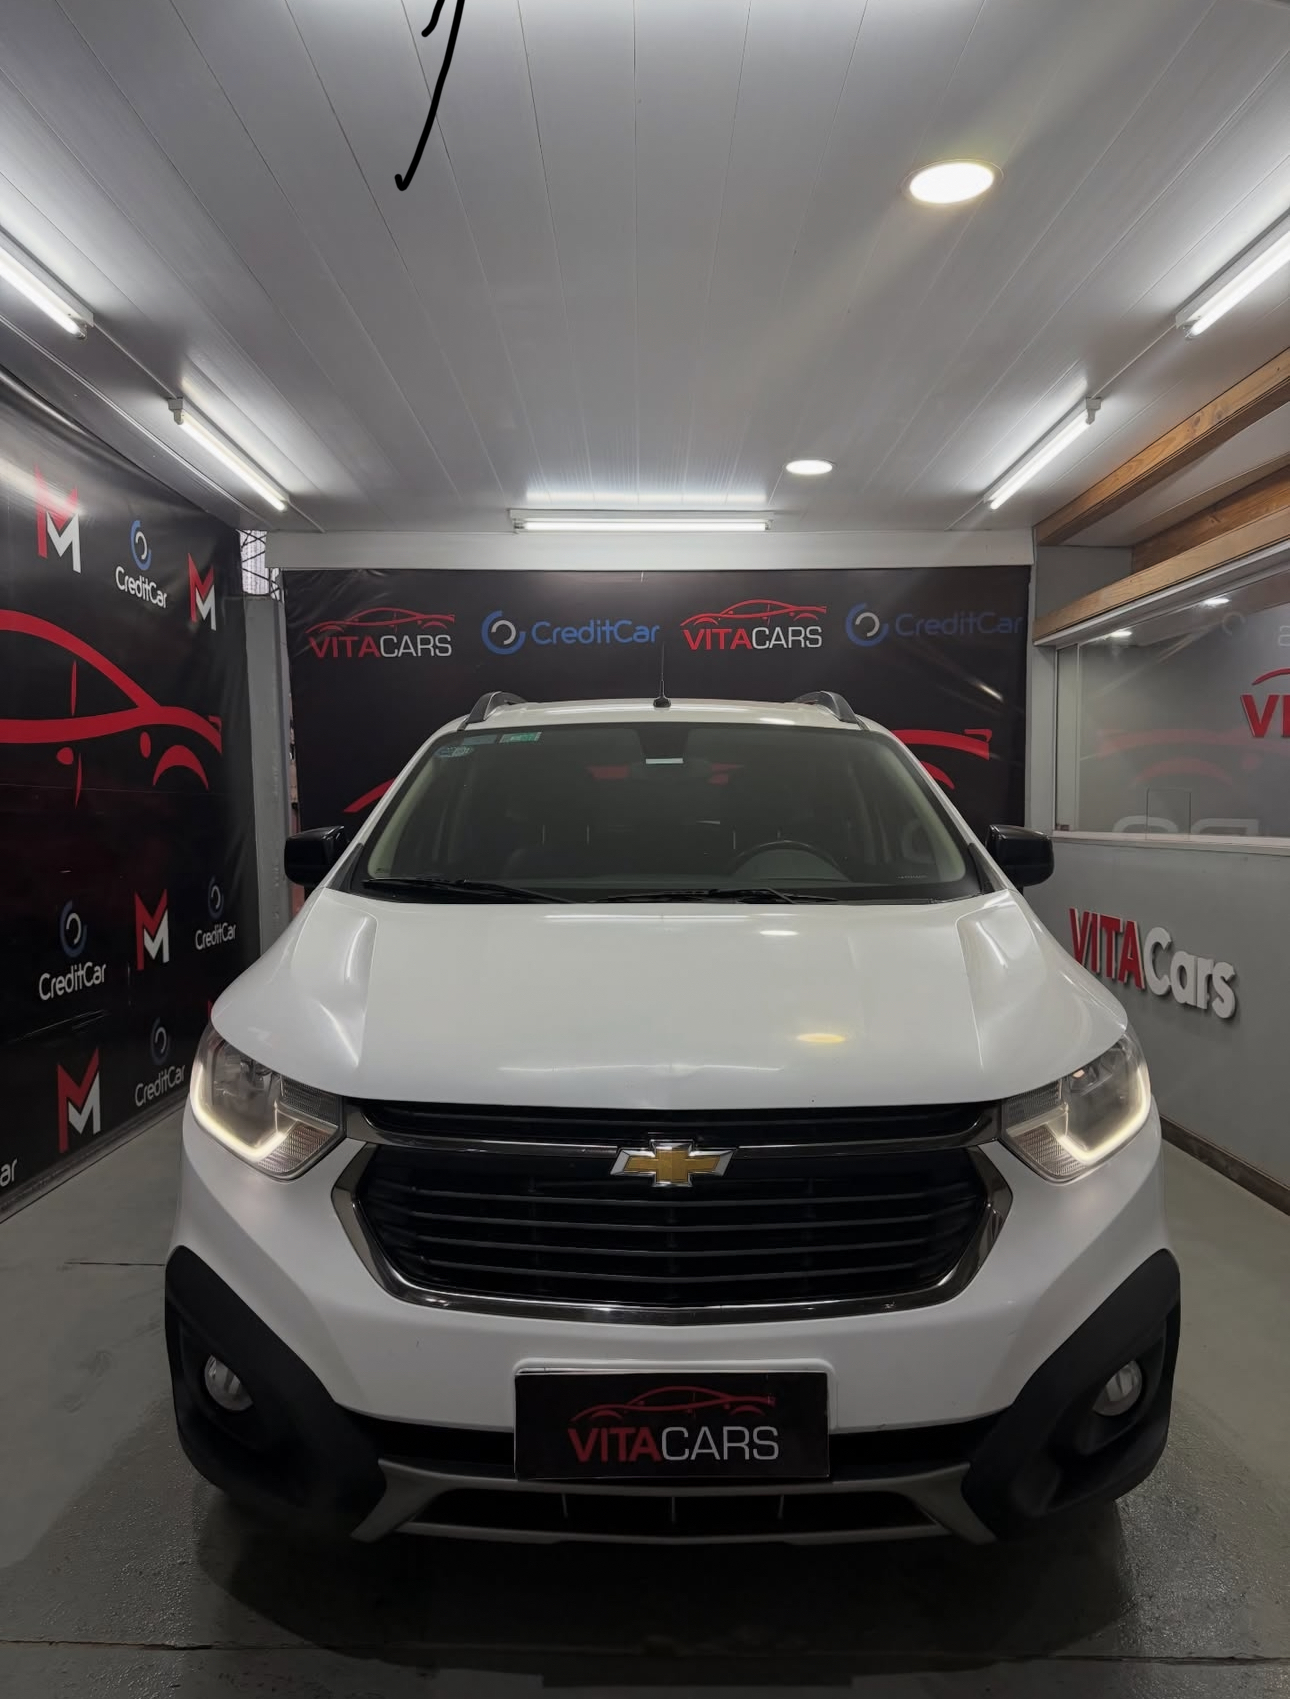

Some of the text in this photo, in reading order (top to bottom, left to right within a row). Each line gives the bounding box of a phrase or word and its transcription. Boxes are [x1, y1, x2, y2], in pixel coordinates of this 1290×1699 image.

[115, 565, 167, 609] CreditCar
[531, 618, 660, 645] CreditCar
[683, 625, 823, 651] VITACARS
[894, 611, 1023, 638] CreditCar
[307, 634, 453, 659] VITACARS
[195, 921, 237, 951] CreditCar
[1068, 907, 1236, 1020] VITACars
[39, 961, 107, 1001] CreditCar
[135, 1063, 186, 1107] CreditCar
[567, 1426, 780, 1463] VITACARS
